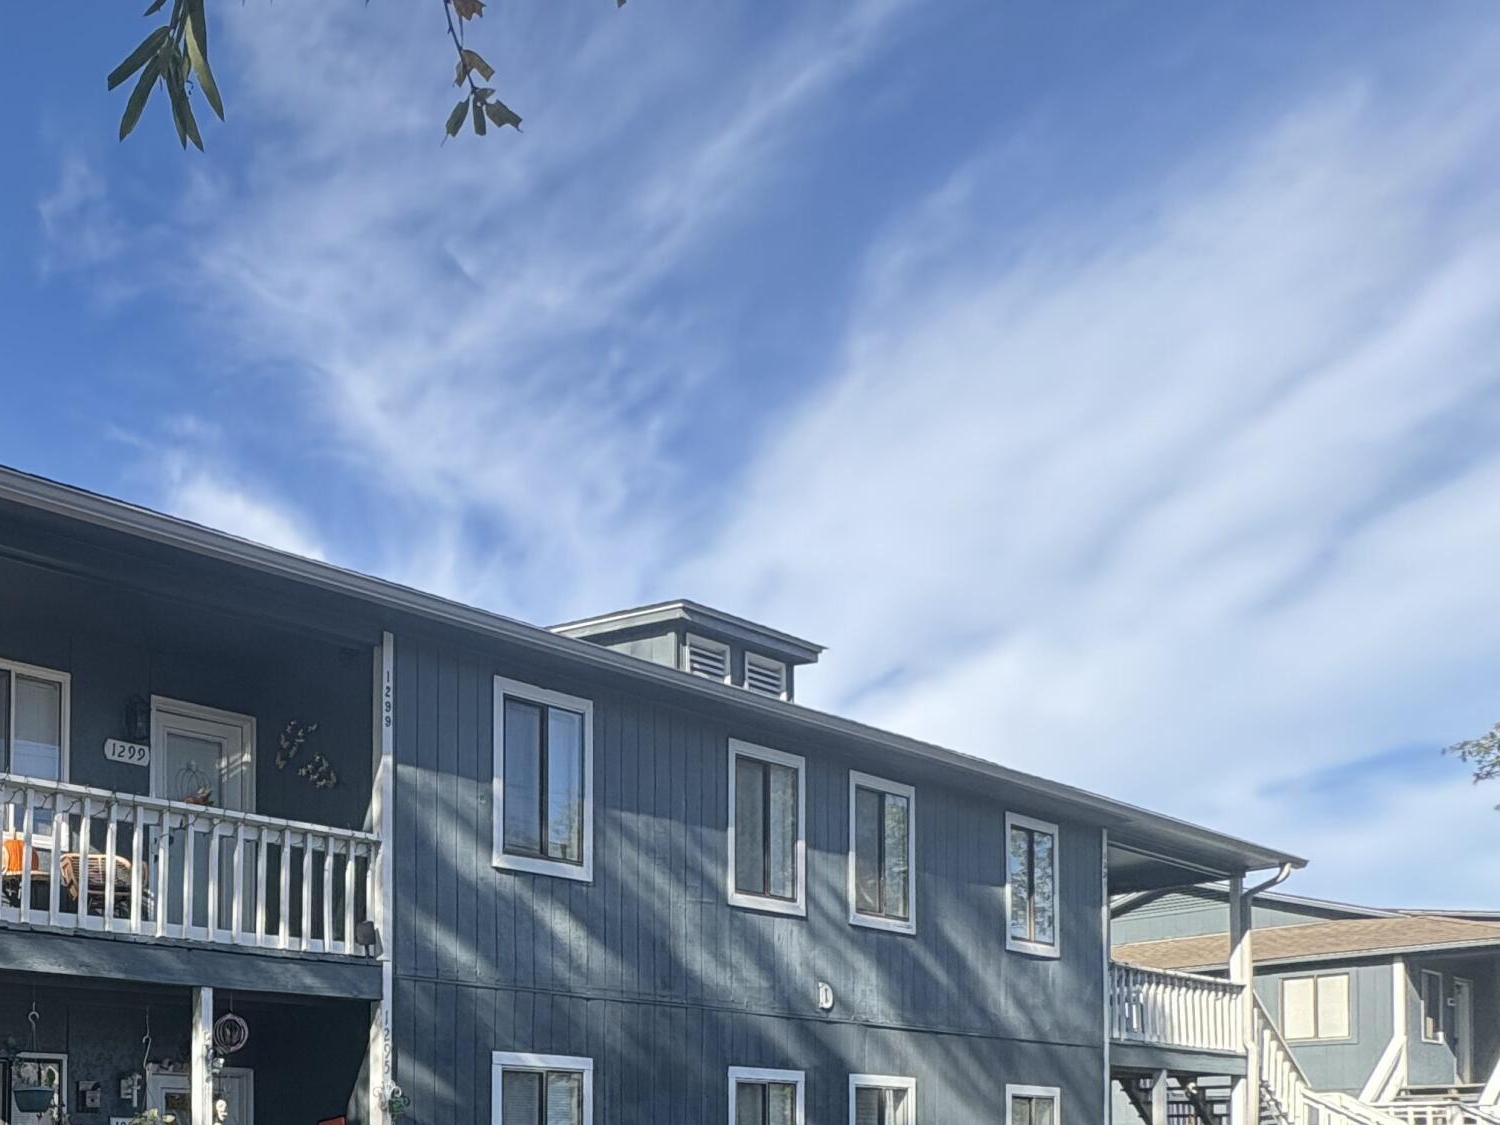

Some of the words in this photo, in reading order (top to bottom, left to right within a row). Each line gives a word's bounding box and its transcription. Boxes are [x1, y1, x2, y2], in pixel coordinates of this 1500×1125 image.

[112, 743, 146, 761] 1299
[818, 981, 833, 1009] D
[383, 1010, 391, 1074] 1295
